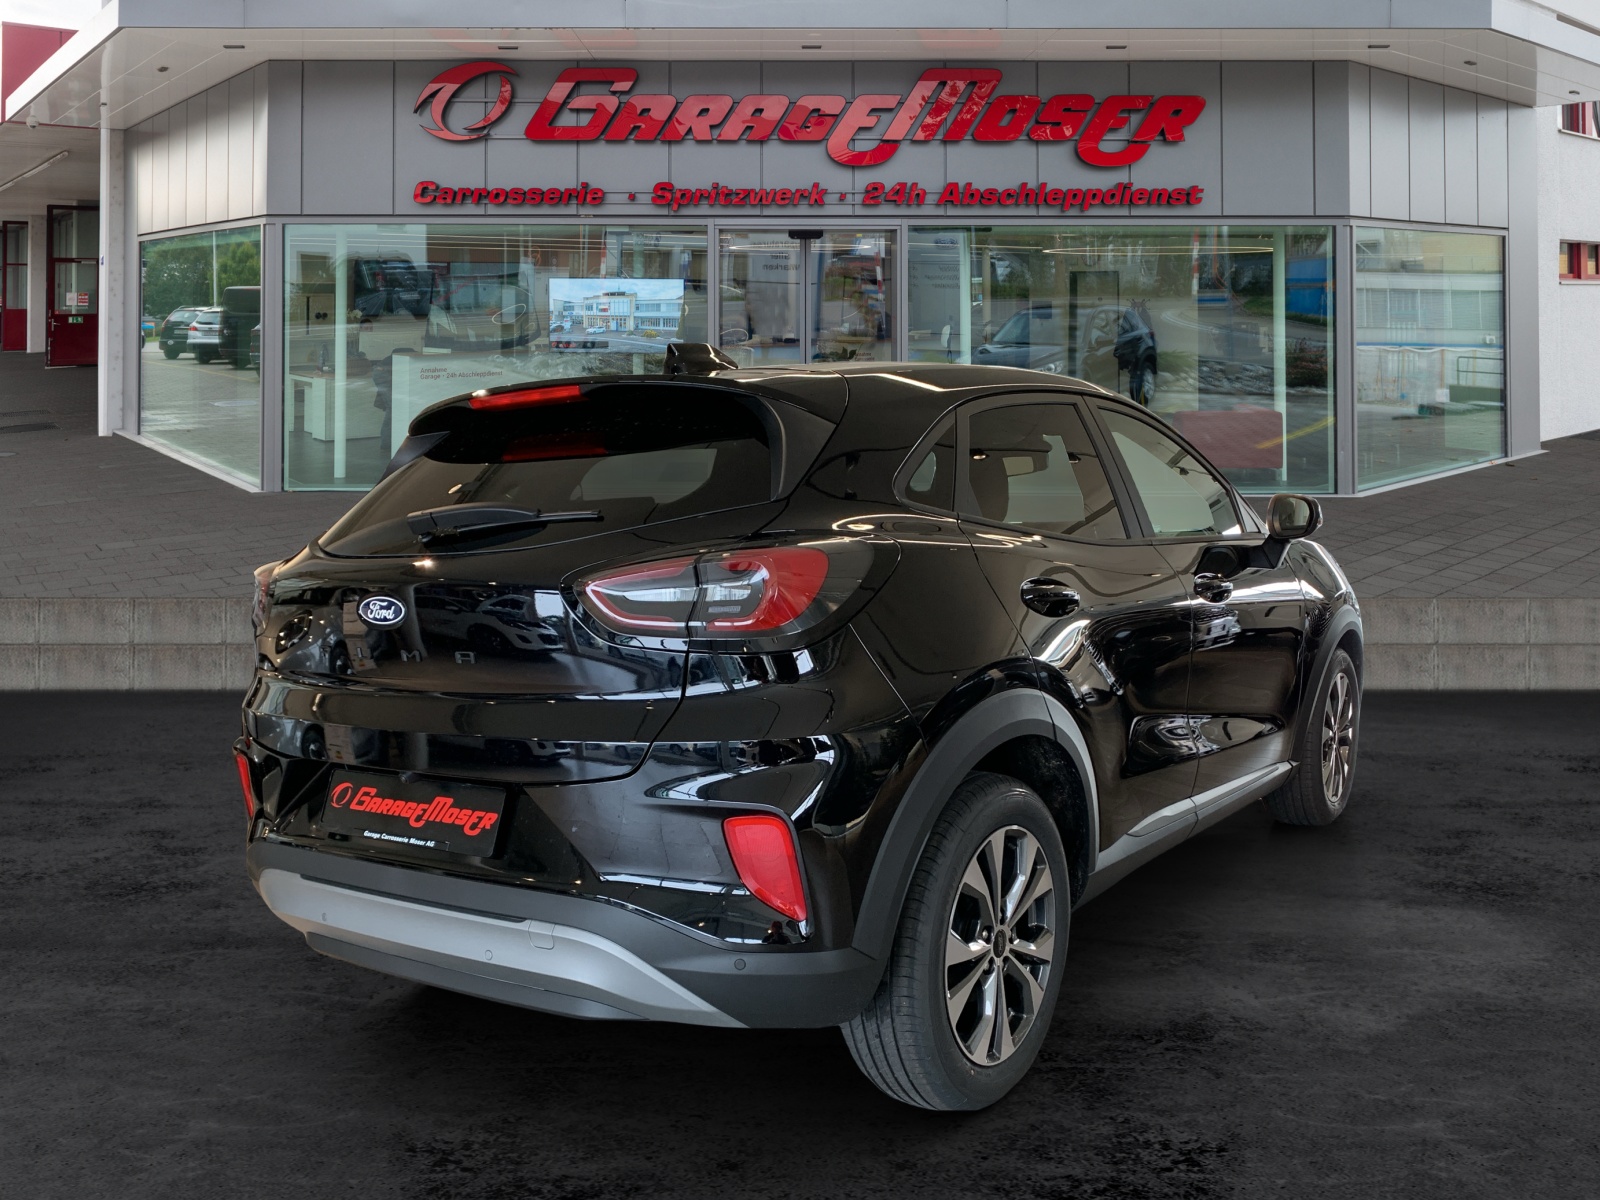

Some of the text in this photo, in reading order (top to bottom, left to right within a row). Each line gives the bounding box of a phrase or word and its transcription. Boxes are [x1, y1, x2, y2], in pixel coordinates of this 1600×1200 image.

[413, 181, 1204, 211] Carrosserie Spritzwerk 24h Abschleppdienst
[459, 370, 503, 378] Abschleppdienst
[367, 600, 395, 620] Ford
[363, 830, 381, 839] Garage
[381, 833, 409, 844] Carrosserie
[409, 837, 426, 846] Moser
